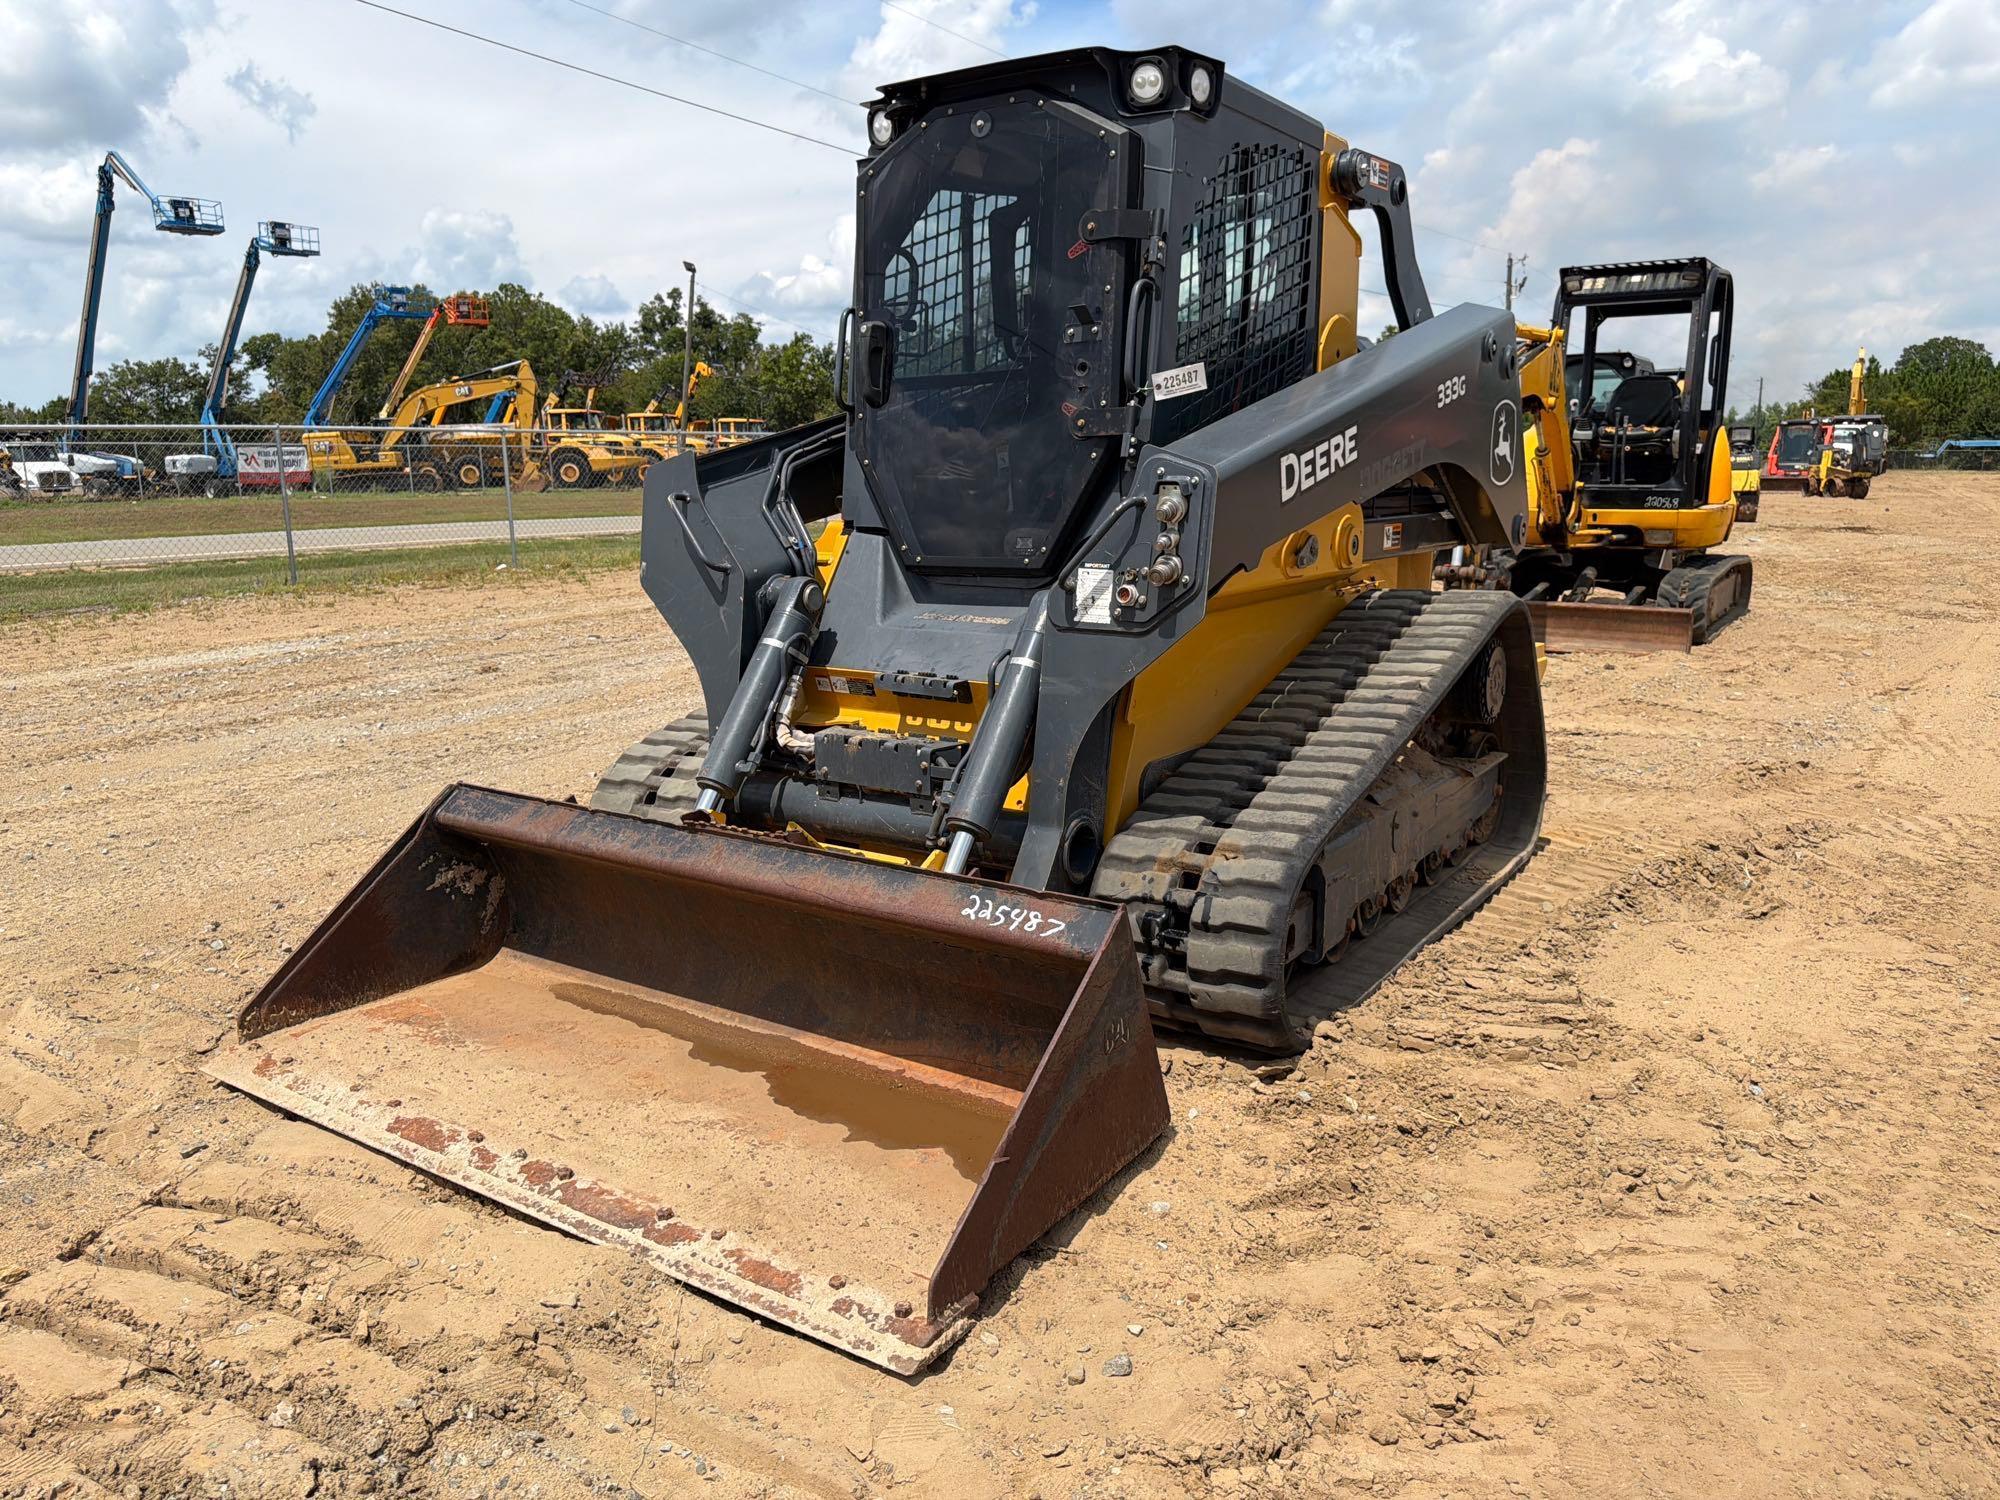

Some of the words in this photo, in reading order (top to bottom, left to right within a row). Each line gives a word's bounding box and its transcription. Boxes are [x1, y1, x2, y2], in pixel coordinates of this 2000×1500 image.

[1163, 370, 1198, 390] 225487
[455, 387, 470, 396] CAT
[1437, 375, 1466, 409] 333G
[313, 441, 330, 452] CAT
[264, 459, 277, 468] BUY
[281, 458, 302, 468] ODAY!
[1280, 425, 1358, 503] DEERE
[961, 895, 1066, 937] 225487
